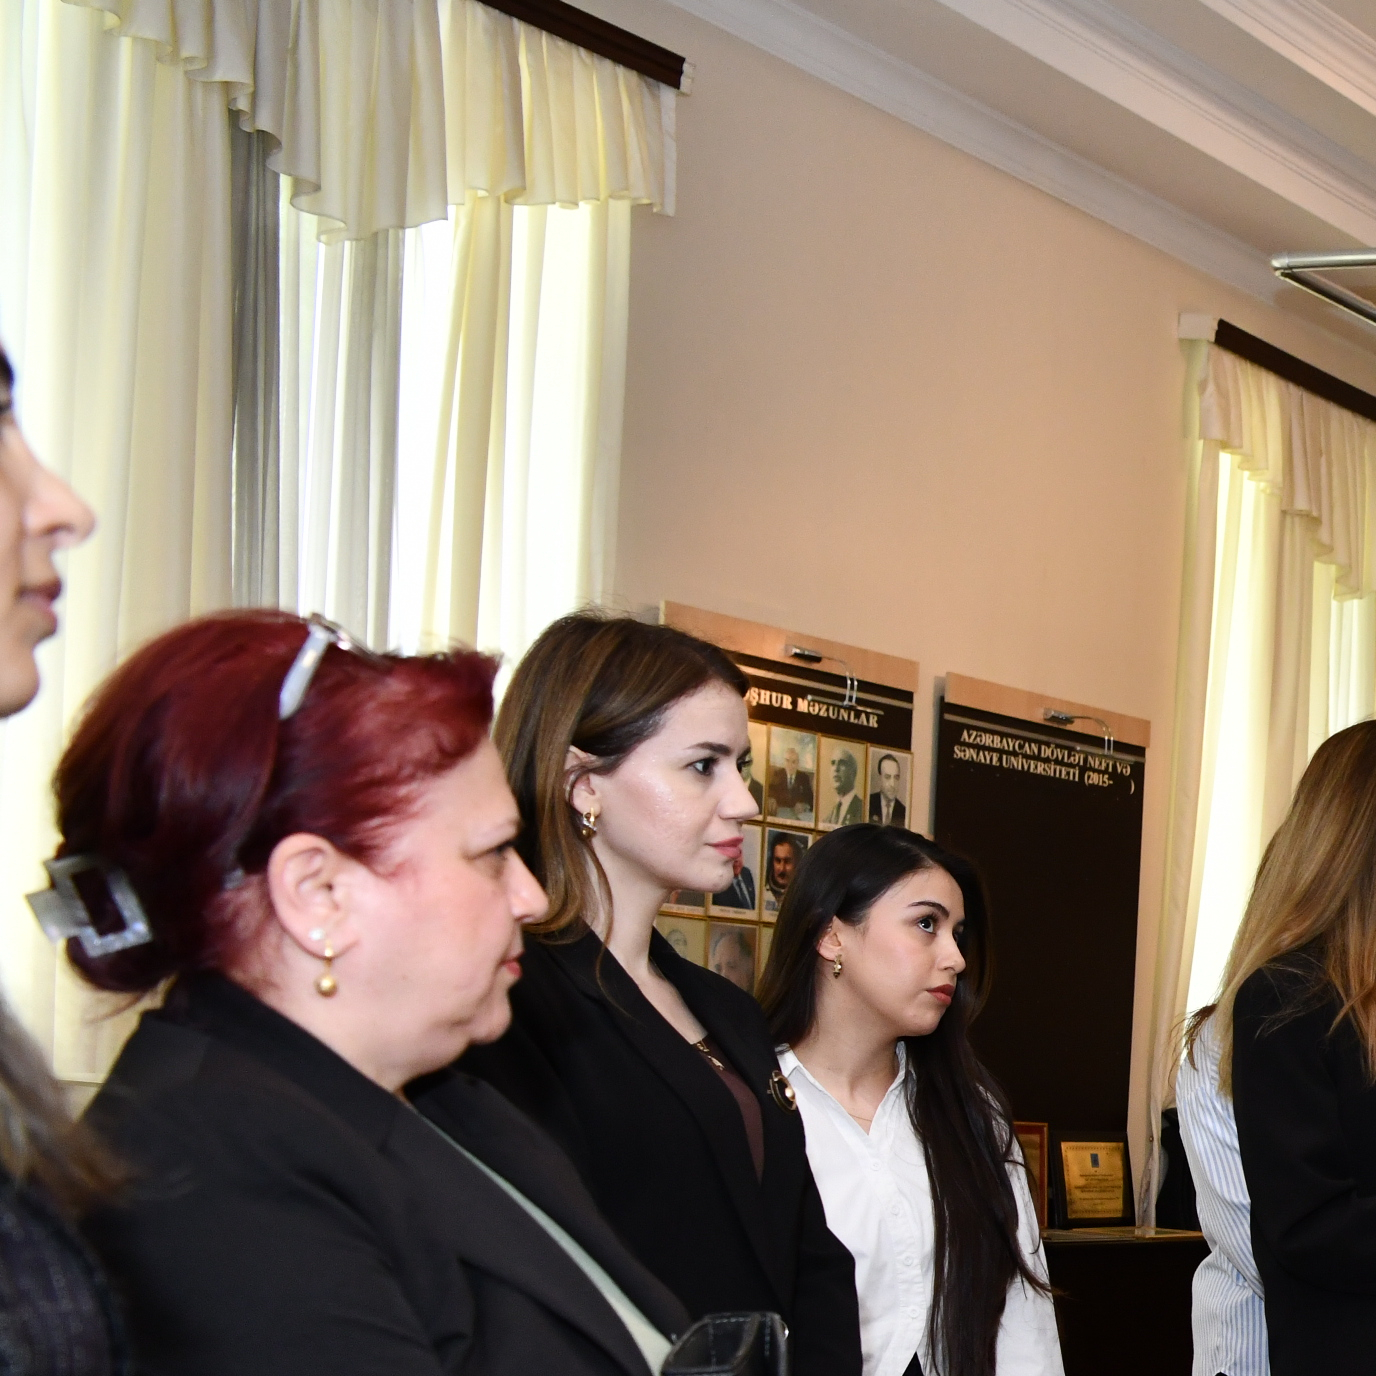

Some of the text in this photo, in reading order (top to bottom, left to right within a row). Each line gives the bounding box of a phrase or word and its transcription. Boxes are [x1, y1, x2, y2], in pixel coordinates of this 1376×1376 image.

[796, 697, 879, 728] MƏZUNLAR
[953, 745, 1000, 767] SƏNAYE
[1002, 754, 1080, 782] UNİVERSİTETİ
[960, 729, 1131, 776] AZƏRBAYCAN DÖVLƏT NEFT VƏ
